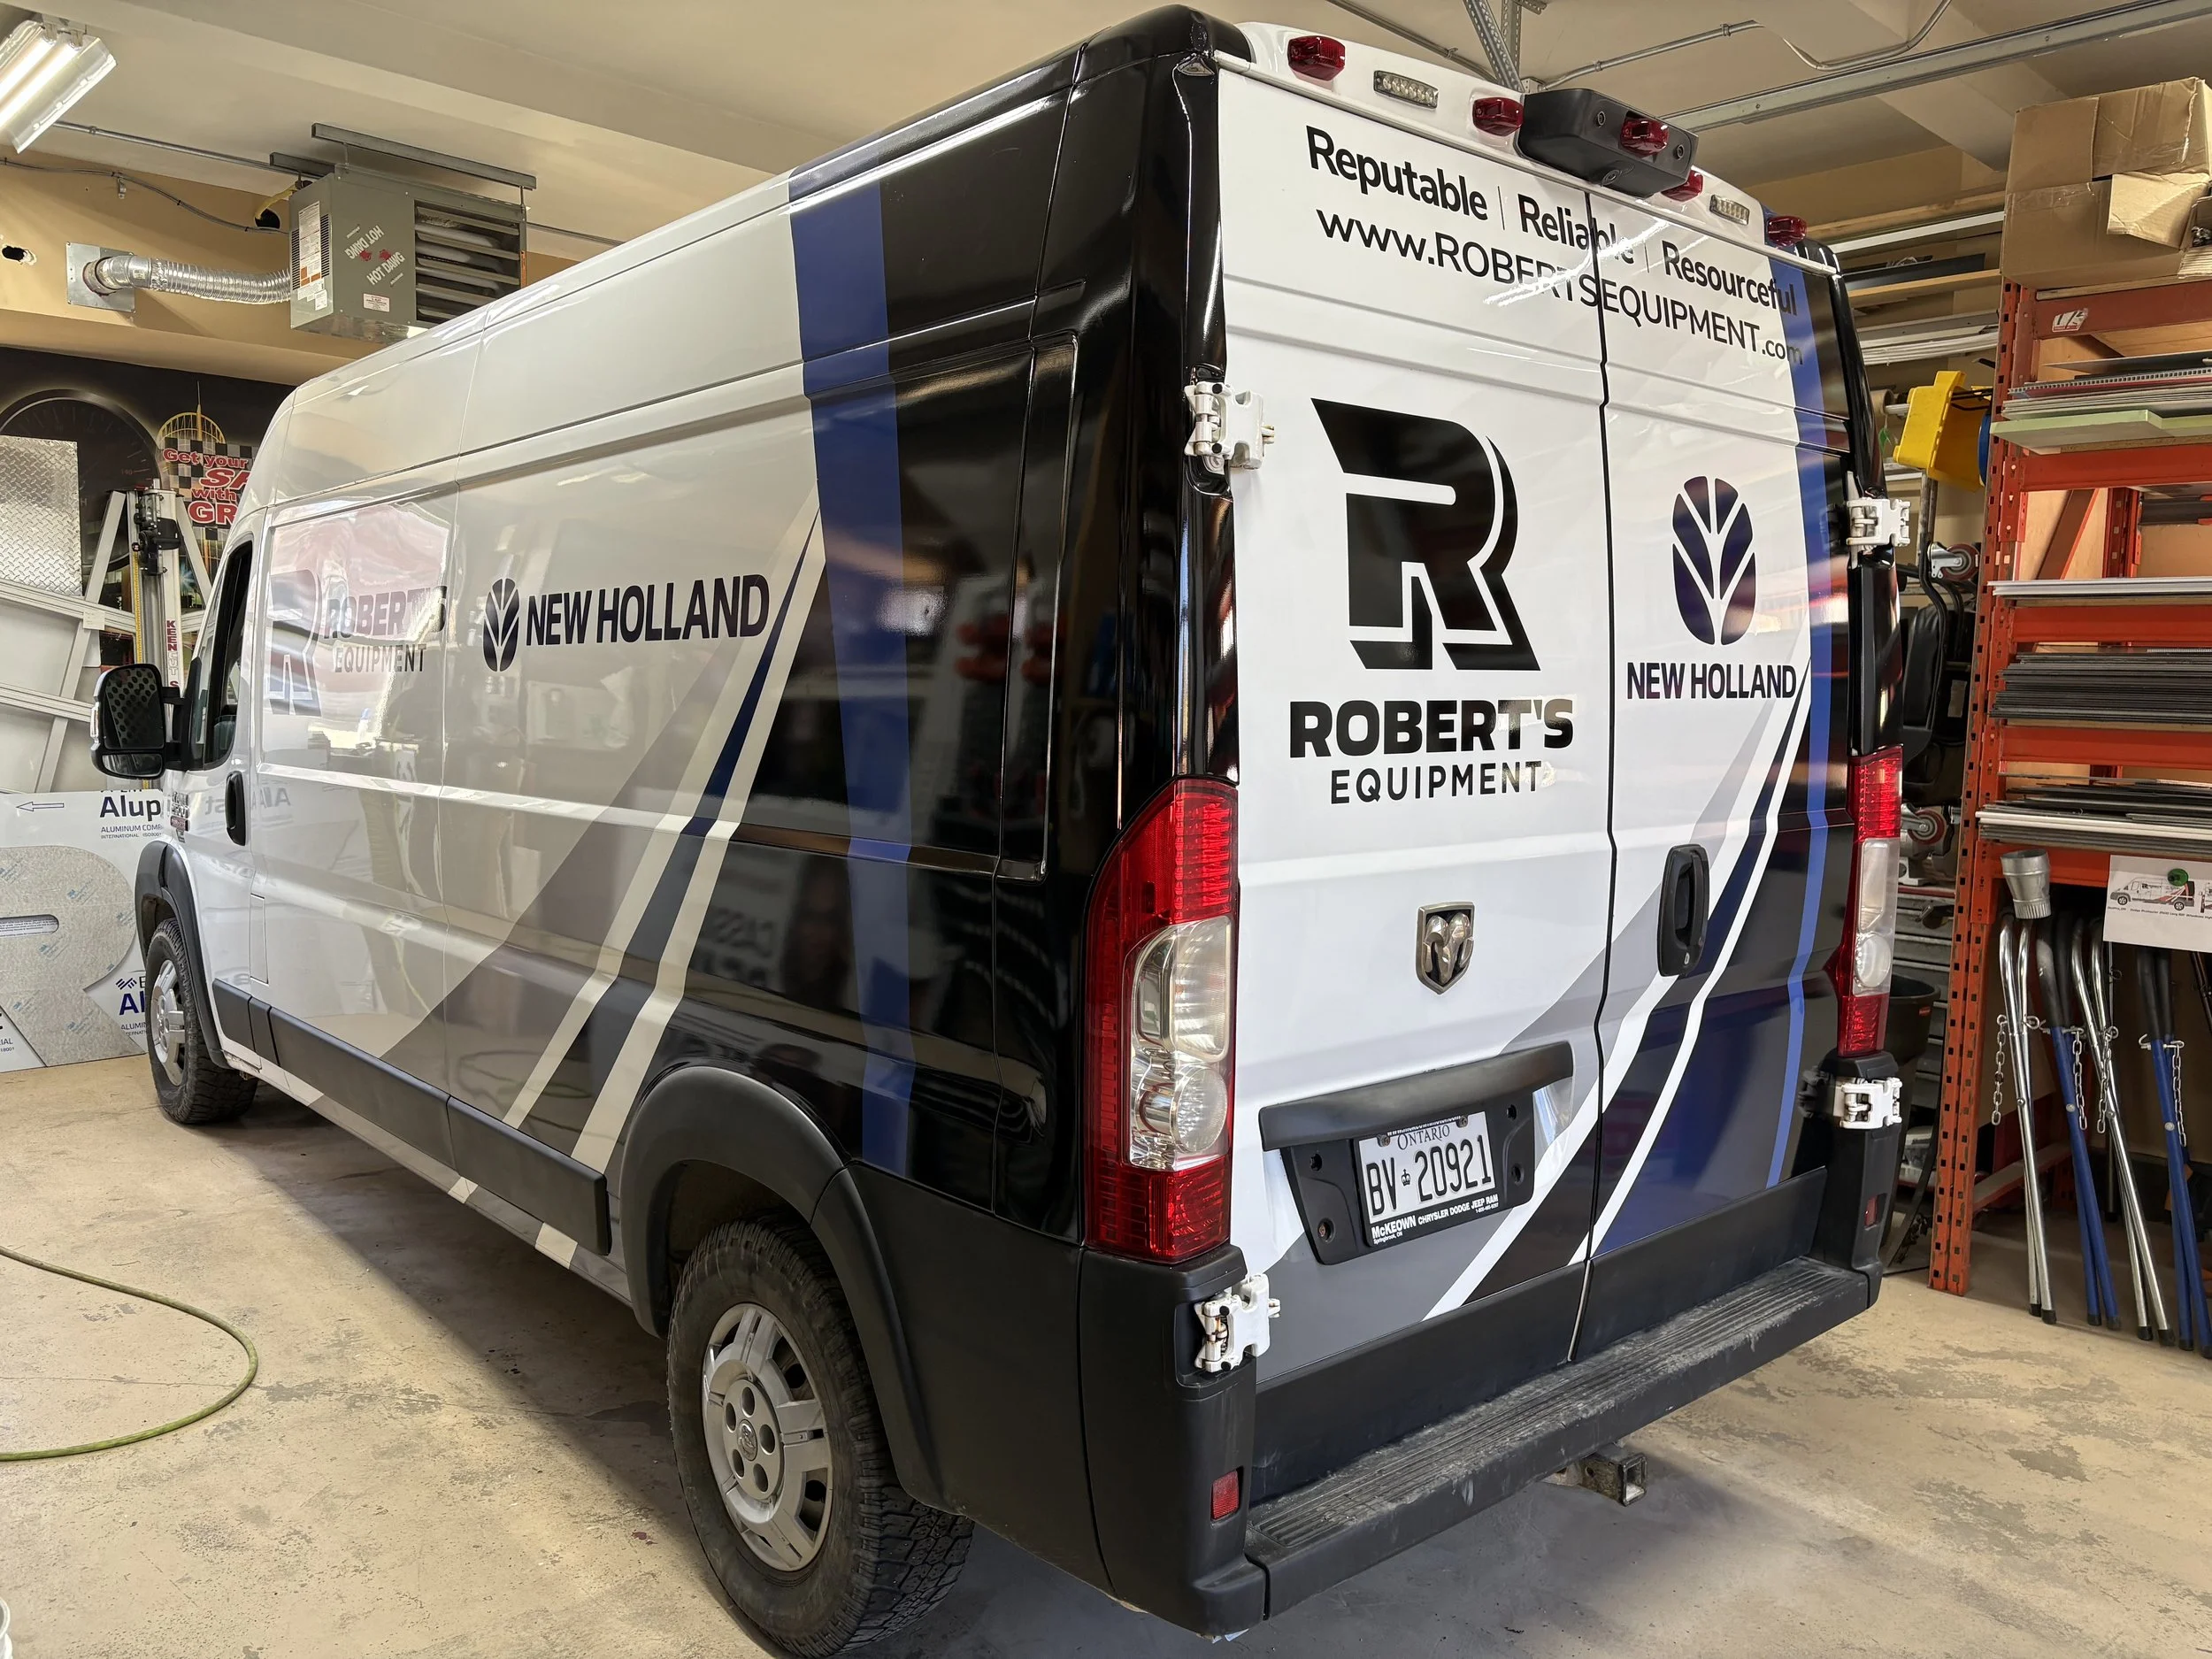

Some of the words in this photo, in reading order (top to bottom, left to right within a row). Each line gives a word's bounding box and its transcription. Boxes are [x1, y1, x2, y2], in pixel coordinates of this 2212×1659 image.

[1305, 125, 1487, 220] Reputable
[1517, 195, 1634, 265] Reliable
[1662, 241, 1798, 317] Resourceful
[366, 265, 386, 285] HOT
[381, 251, 405, 273] DAWG
[1316, 208, 1804, 365] www.ROBERTSEQUIPMENT.com
[163, 448, 199, 464] Get
[204, 455, 249, 469] your
[192, 488, 237, 502] with
[526, 589, 592, 646] NEW
[596, 573, 770, 644] HOLLAND
[334, 643, 426, 673] EQUIPMENT
[1627, 662, 1686, 699] NEW
[1691, 663, 1797, 699] HOLLAND
[1290, 698, 1574, 758] ROBERT'S
[1331, 760, 1542, 804] EQUIPMENT
[99, 795, 162, 821] Alup
[1397, 1125, 1450, 1150] ONTARIO
[1366, 1157, 1397, 1217] BV
[1415, 1134, 1492, 1202] 20921
[1371, 1215, 1417, 1240] McKEOWN
[1417, 1208, 1449, 1225] CHRYSLER
[1449, 1202, 1471, 1216] DODGE
[1471, 1197, 1486, 1210] JEEP
[1486, 1194, 1499, 1205] RAM
